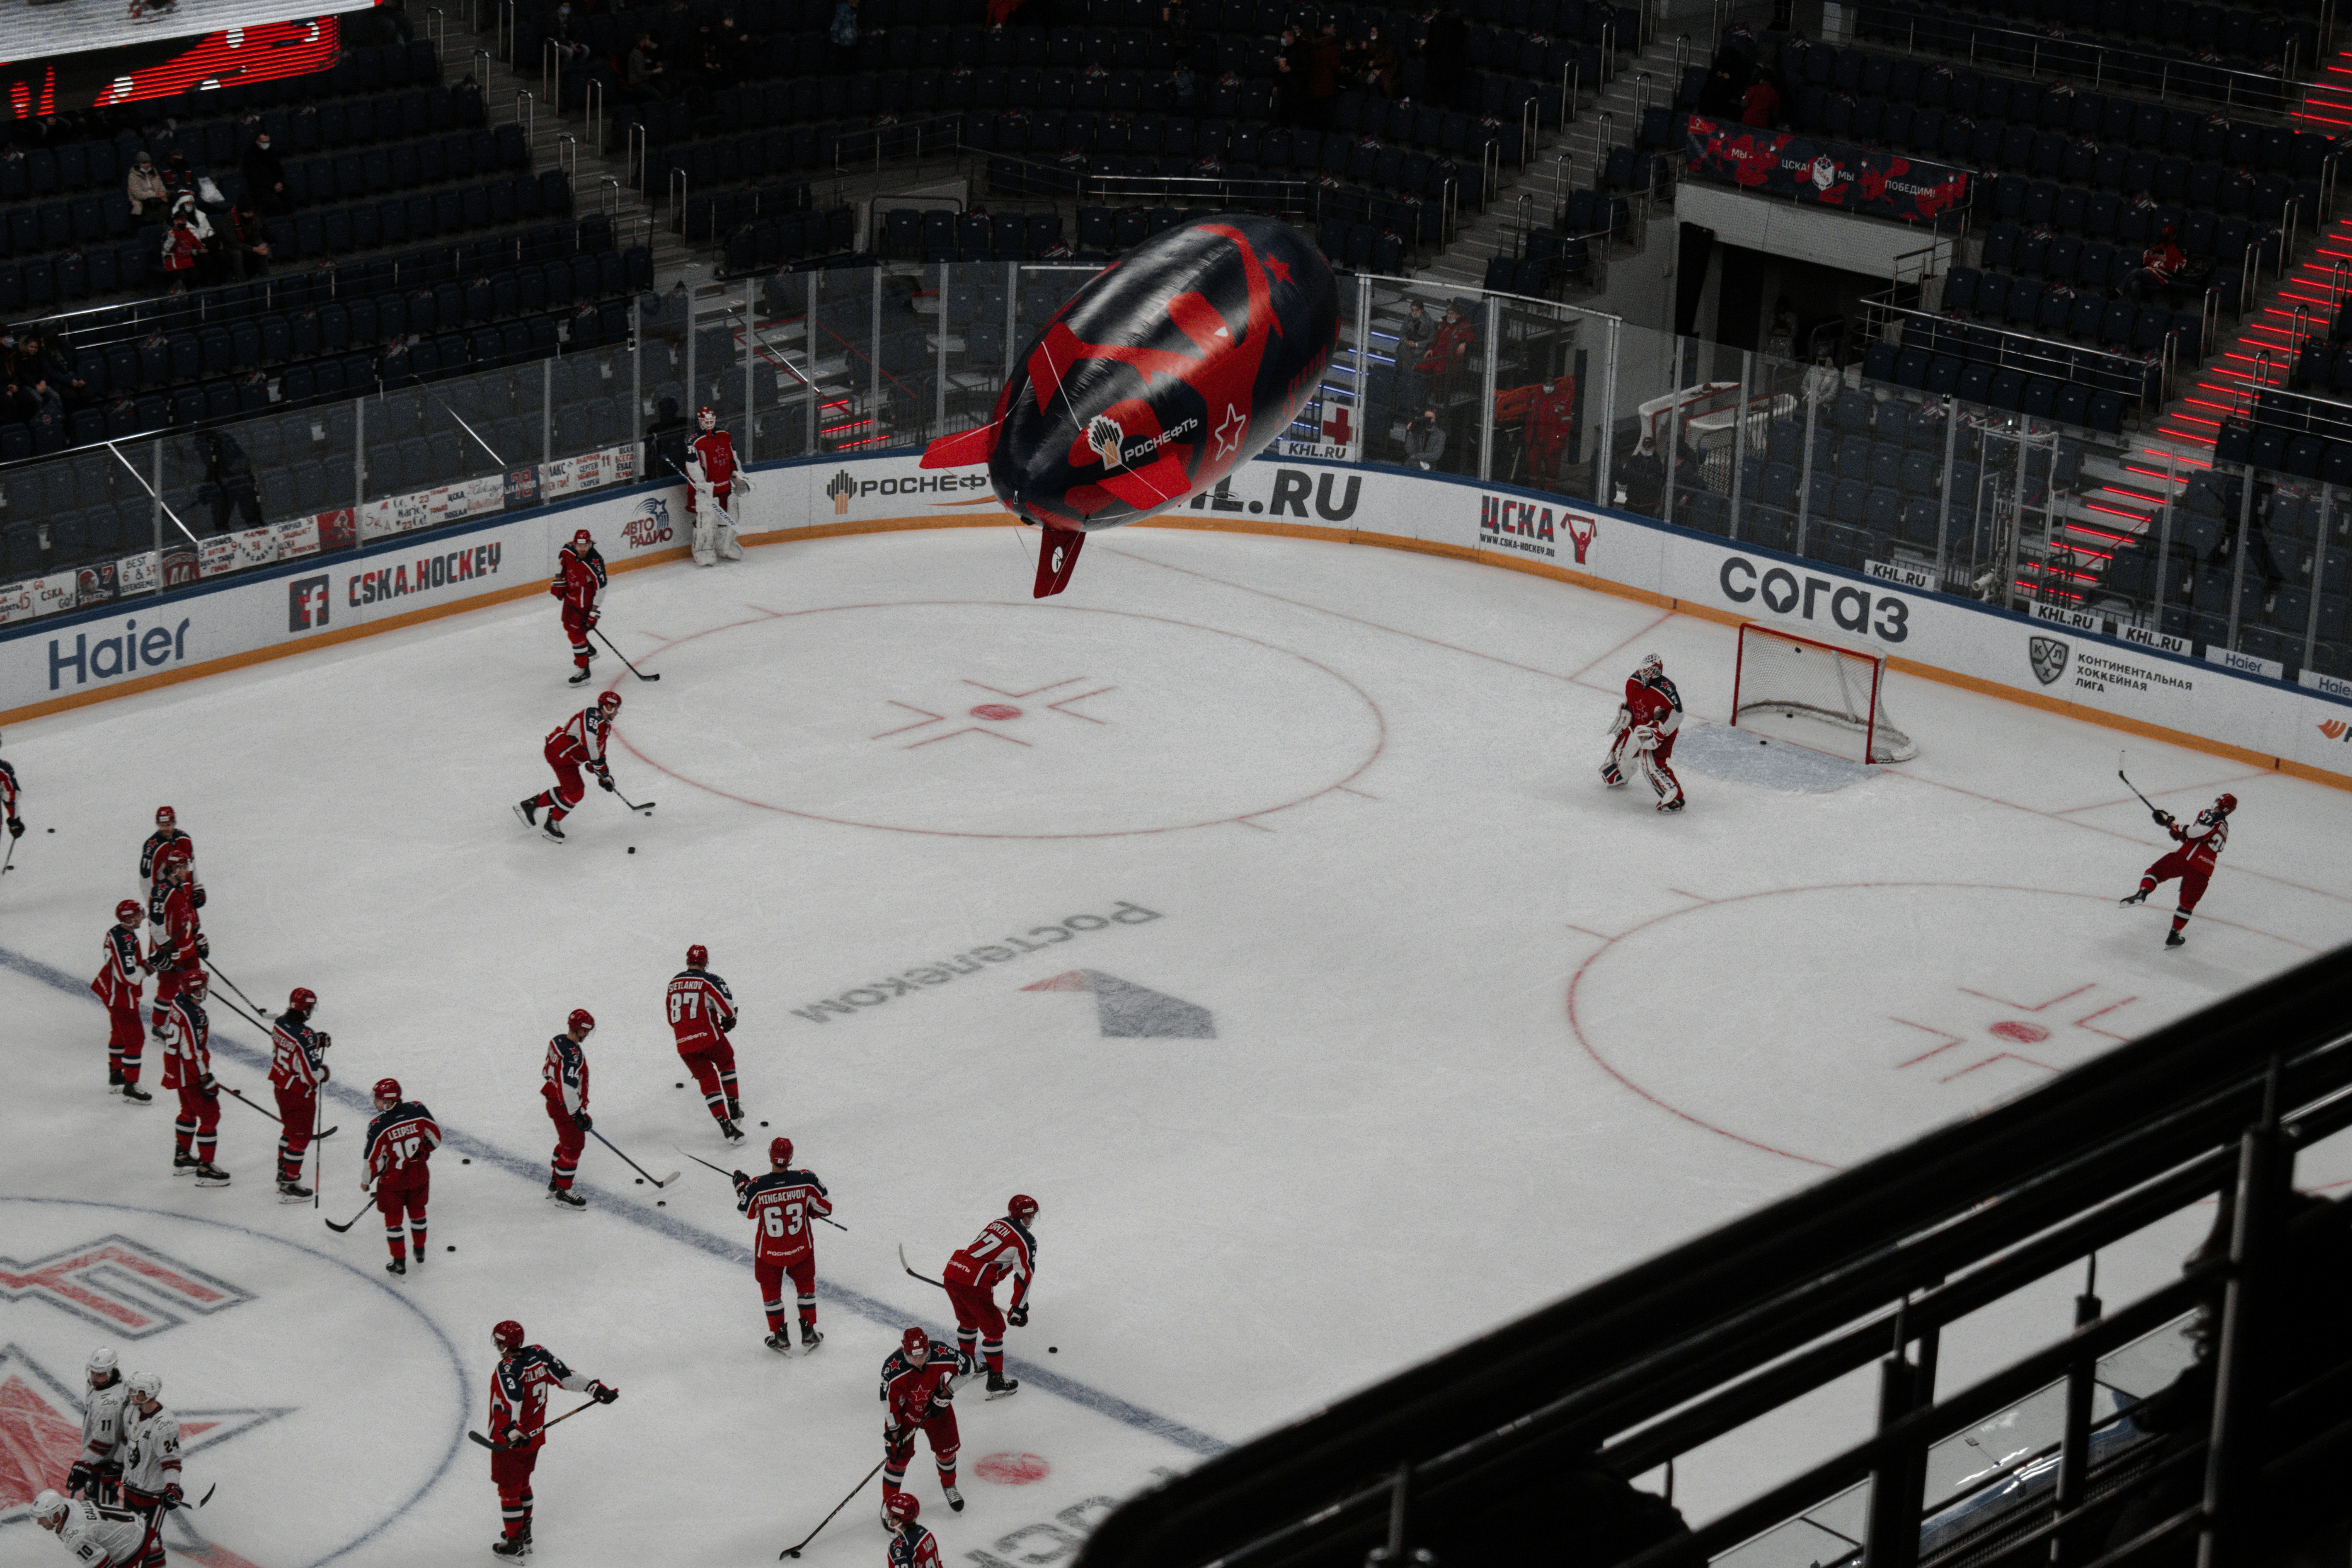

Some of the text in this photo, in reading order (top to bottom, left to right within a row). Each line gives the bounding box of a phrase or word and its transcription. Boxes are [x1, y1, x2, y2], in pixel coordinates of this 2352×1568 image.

[1731, 148, 1747, 160] МЫ
[1782, 159, 1810, 172] ЦСКА!
[1838, 170, 1855, 182] МЫ
[1885, 180, 1936, 198] ПОБЕДИМ!
[1124, 418, 1198, 462] РОСНЕФТЬ
[615, 453, 633, 464] ВСЕГД
[1289, 443, 1346, 459] KHL.RU
[580, 462, 598, 473] СЕРГЕЙ
[602, 455, 610, 467] 11
[860, 474, 990, 497] РОСНЕФ
[1189, 469, 1362, 521] L.RU
[419, 494, 429, 503] 23
[402, 521, 412, 530] 23
[620, 517, 654, 538] АВТО
[1481, 495, 1555, 543] ЦСКА
[231, 541, 237, 551] 9
[630, 527, 673, 549] РАДИО
[1480, 533, 1555, 557] WWW.CSKA-HOCKEY.RU
[126, 556, 147, 569] BEST
[102, 565, 115, 584] 7
[122, 571, 129, 582] 6
[349, 542, 501, 608] CSKA.HOCKEY
[1872, 563, 1926, 587] KHL.RU
[41, 587, 63, 601] CSKA
[2038, 605, 2094, 630] KHL.RU
[2126, 628, 2182, 652] KHL.RU
[49, 618, 190, 691] Haier
[2225, 653, 2262, 672] Haier
[2077, 666, 2148, 691] ХОККЕЙНАЯ
[2078, 653, 2193, 691] КОНТИНЕНТАЛЬНАЯ
[2076, 678, 2105, 693] ЛИГА
[2319, 677, 2352, 696] Haie
[153, 902, 165, 914] 23
[791, 900, 1165, 1024] Ростелеком
[668, 980, 704, 993] SVETLAKOV
[670, 991, 700, 1024] 87
[387, 1123, 419, 1141] LEIPSIC
[758, 1188, 806, 1204] MINGACHYOV
[763, 1203, 804, 1238] 63
[101, 1419, 112, 1431] 11
[163, 1439, 179, 1453] 24
[77, 1544, 93, 1561] 10
